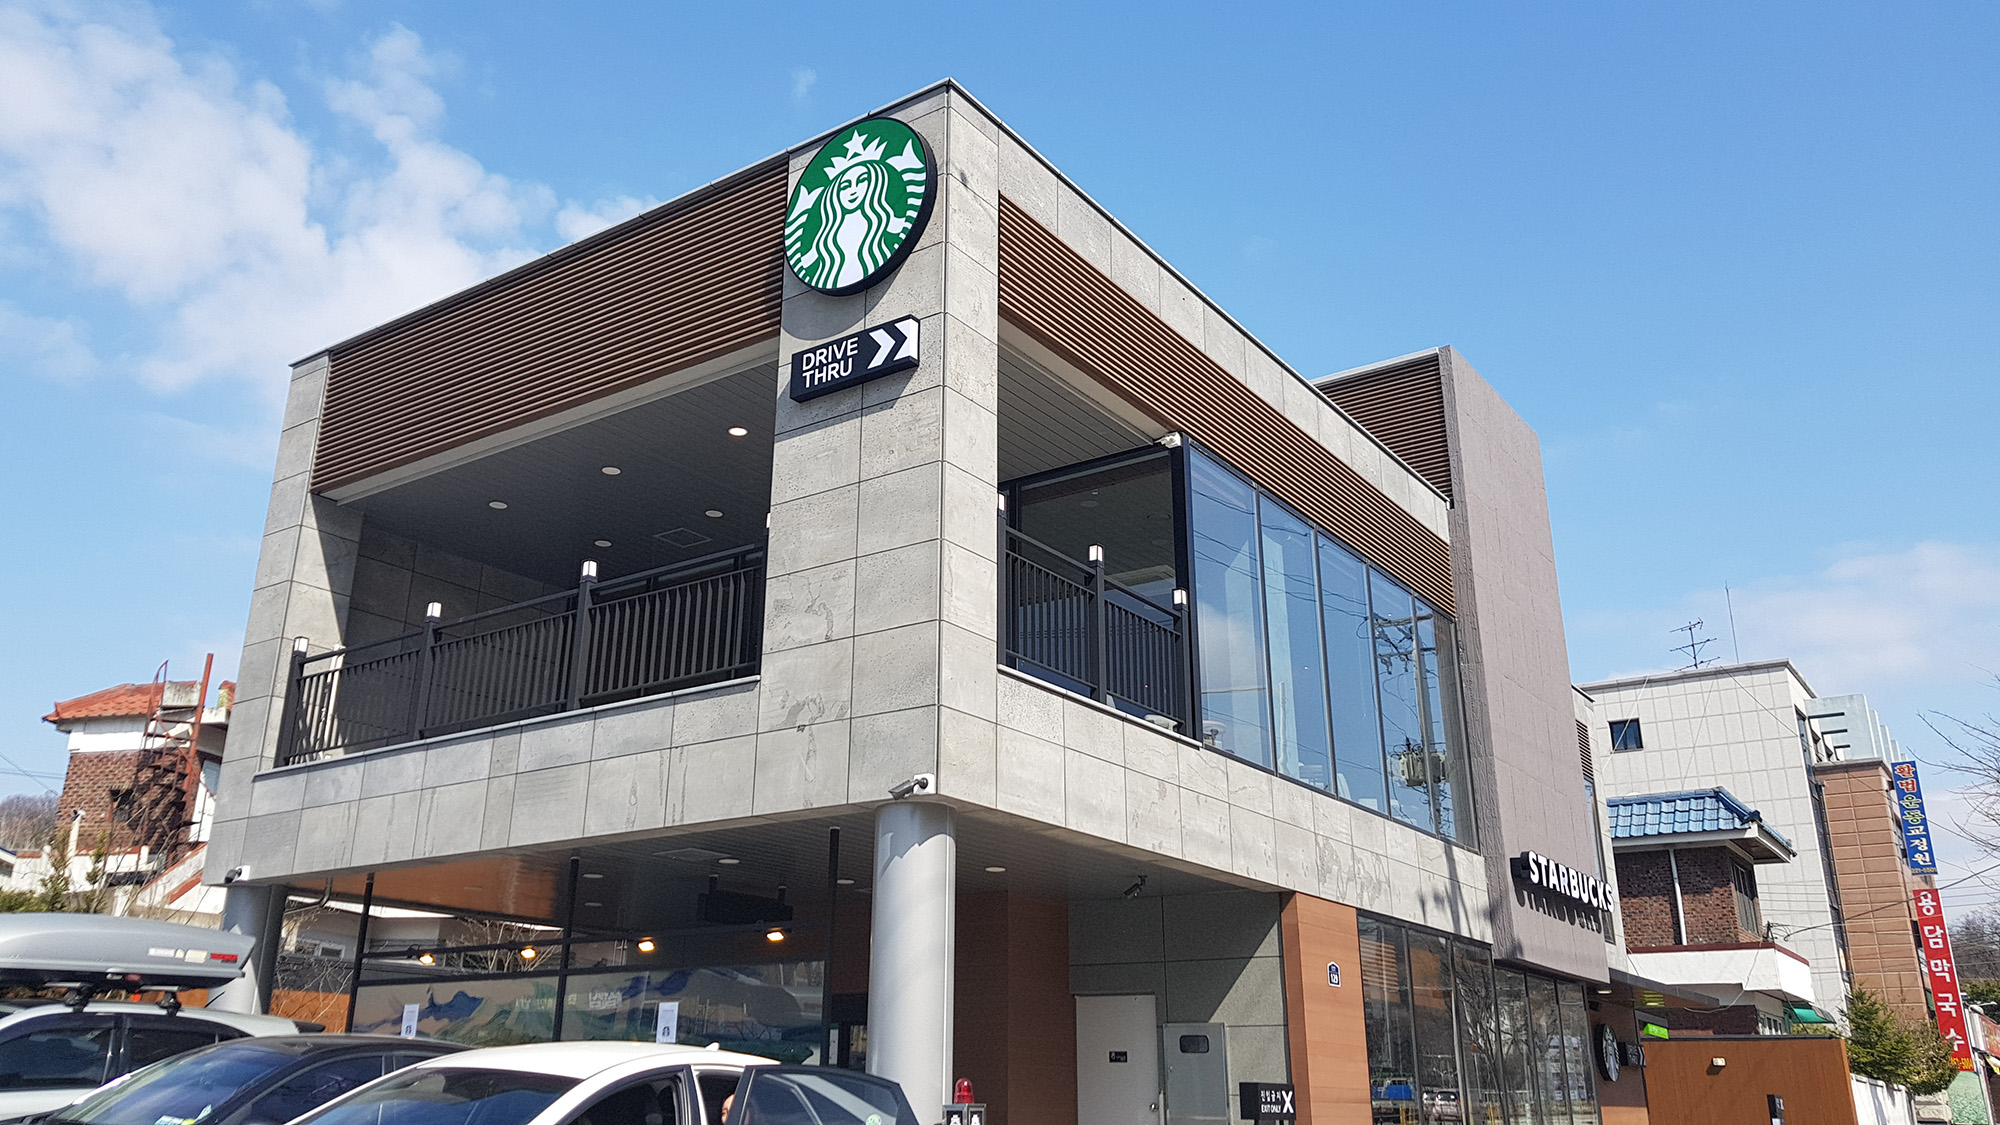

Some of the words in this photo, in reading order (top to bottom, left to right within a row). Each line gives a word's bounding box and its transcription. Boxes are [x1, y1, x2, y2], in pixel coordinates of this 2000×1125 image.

[802, 337, 858, 371] DRIVE
[802, 357, 853, 388] THRU
[1528, 850, 1614, 913] STARBUCKS
[1917, 891, 1965, 1052] 용담막국수
[1261, 1104, 1271, 1113] EXIT
[1271, 1104, 1281, 1113] ONLY
